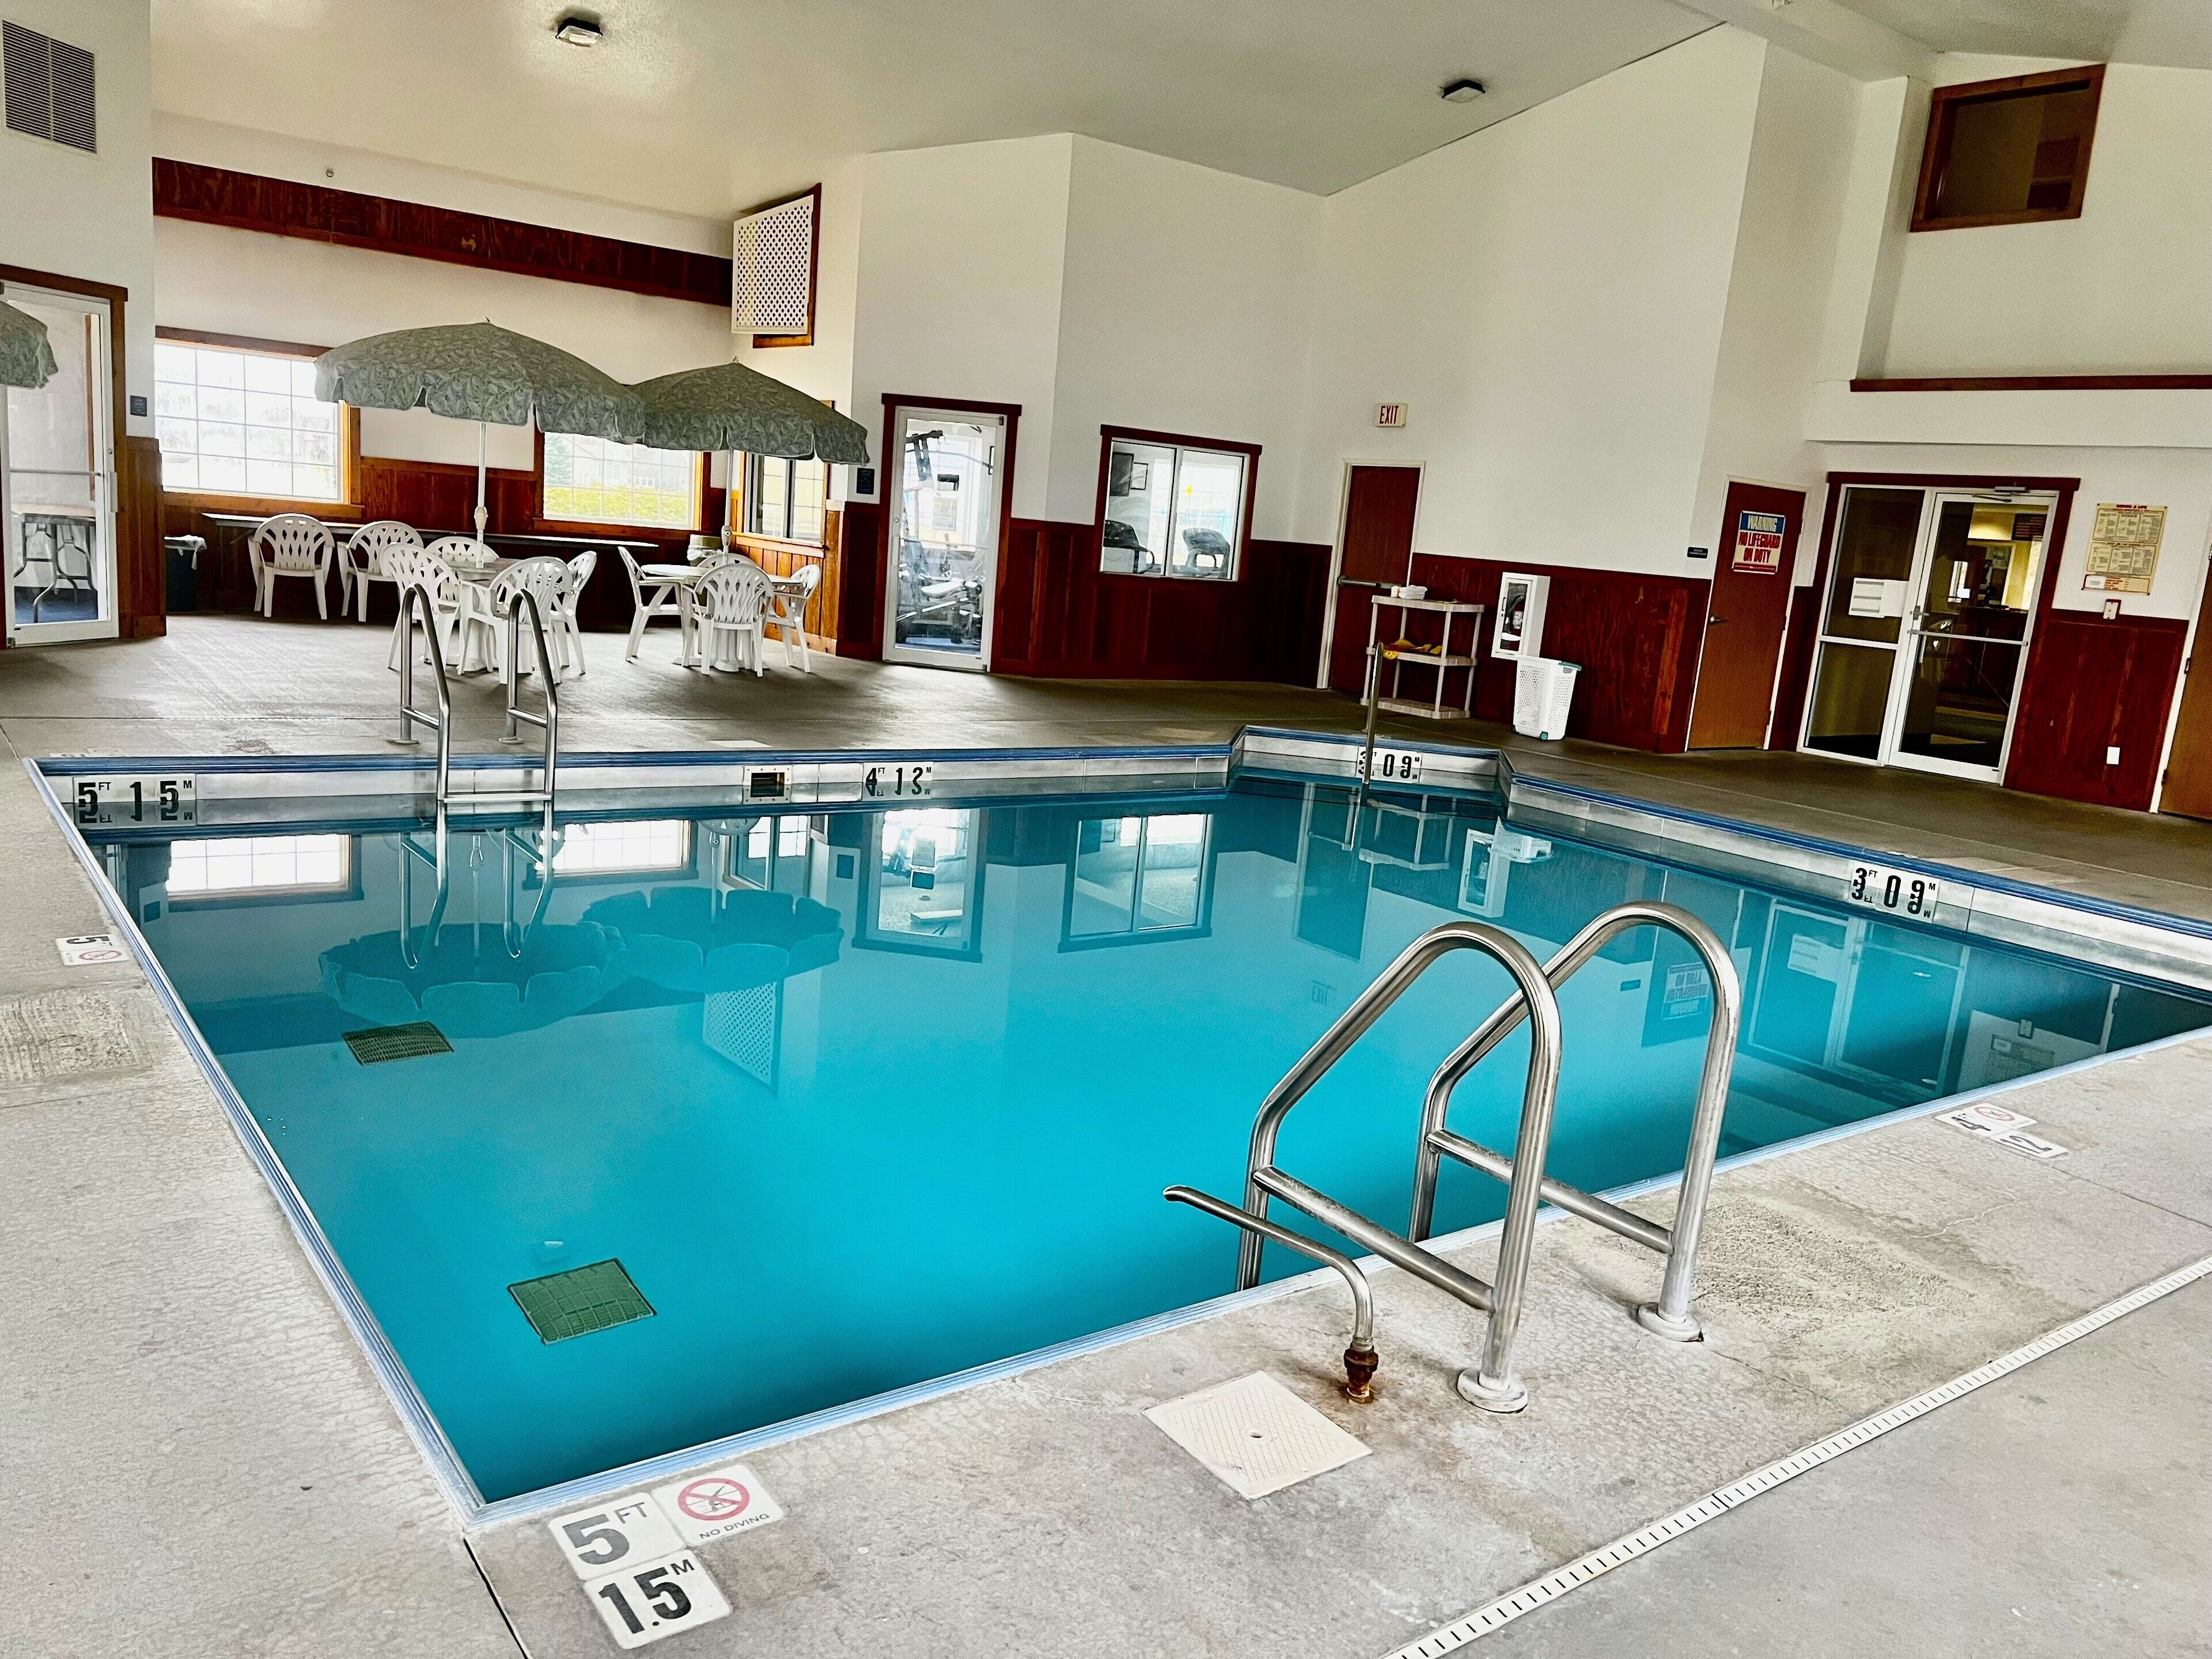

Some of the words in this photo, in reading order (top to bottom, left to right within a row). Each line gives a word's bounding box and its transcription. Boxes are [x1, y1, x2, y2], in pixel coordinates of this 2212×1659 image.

[1379, 405, 1399, 425] EXIT
[1748, 514, 1778, 532] WARNING
[1738, 531, 1748, 546] NO
[1748, 532, 1781, 549] LIFEGUARD
[1743, 547, 1753, 562] ON
[1753, 548, 1771, 563] DUTY
[99, 782, 112, 791] FT
[183, 780, 192, 789] M
[1868, 870, 1878, 878] FT
[1929, 882, 1936, 891] M
[66, 935, 110, 944] 5
[1950, 1116, 1991, 1131] 4
[561, 1513, 630, 1566] 5
[614, 1501, 648, 1525] FT
[699, 1528, 721, 1540] NO
[724, 1513, 771, 1532] DIVING
[598, 1566, 692, 1634] 1.5
[671, 1559, 695, 1576] M
